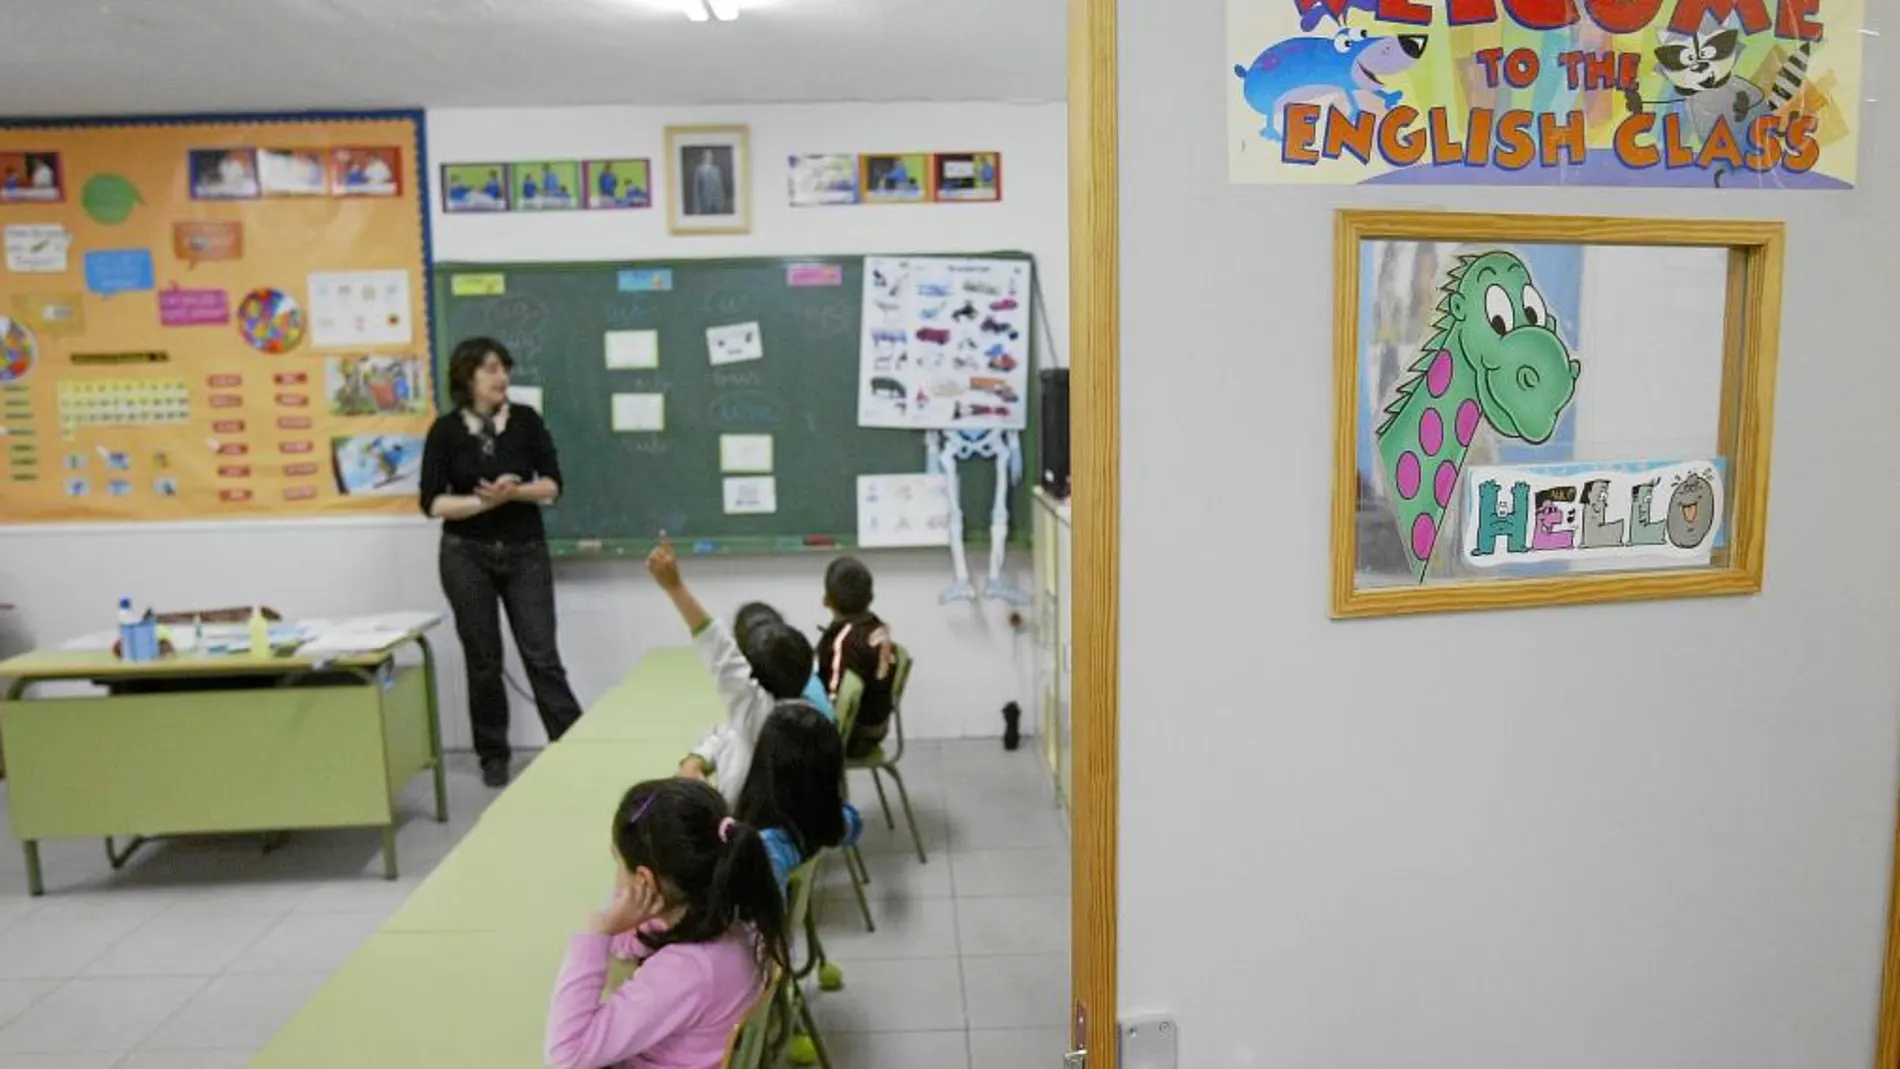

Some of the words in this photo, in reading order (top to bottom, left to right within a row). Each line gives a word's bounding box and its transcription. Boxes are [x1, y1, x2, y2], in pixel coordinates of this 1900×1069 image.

[1475, 47, 1540, 88] TO
[1558, 50, 1640, 91] THE
[1281, 102, 1587, 170] ENGLISH
[1613, 111, 1820, 173] CLASS
[1471, 470, 1716, 556] HELLO
